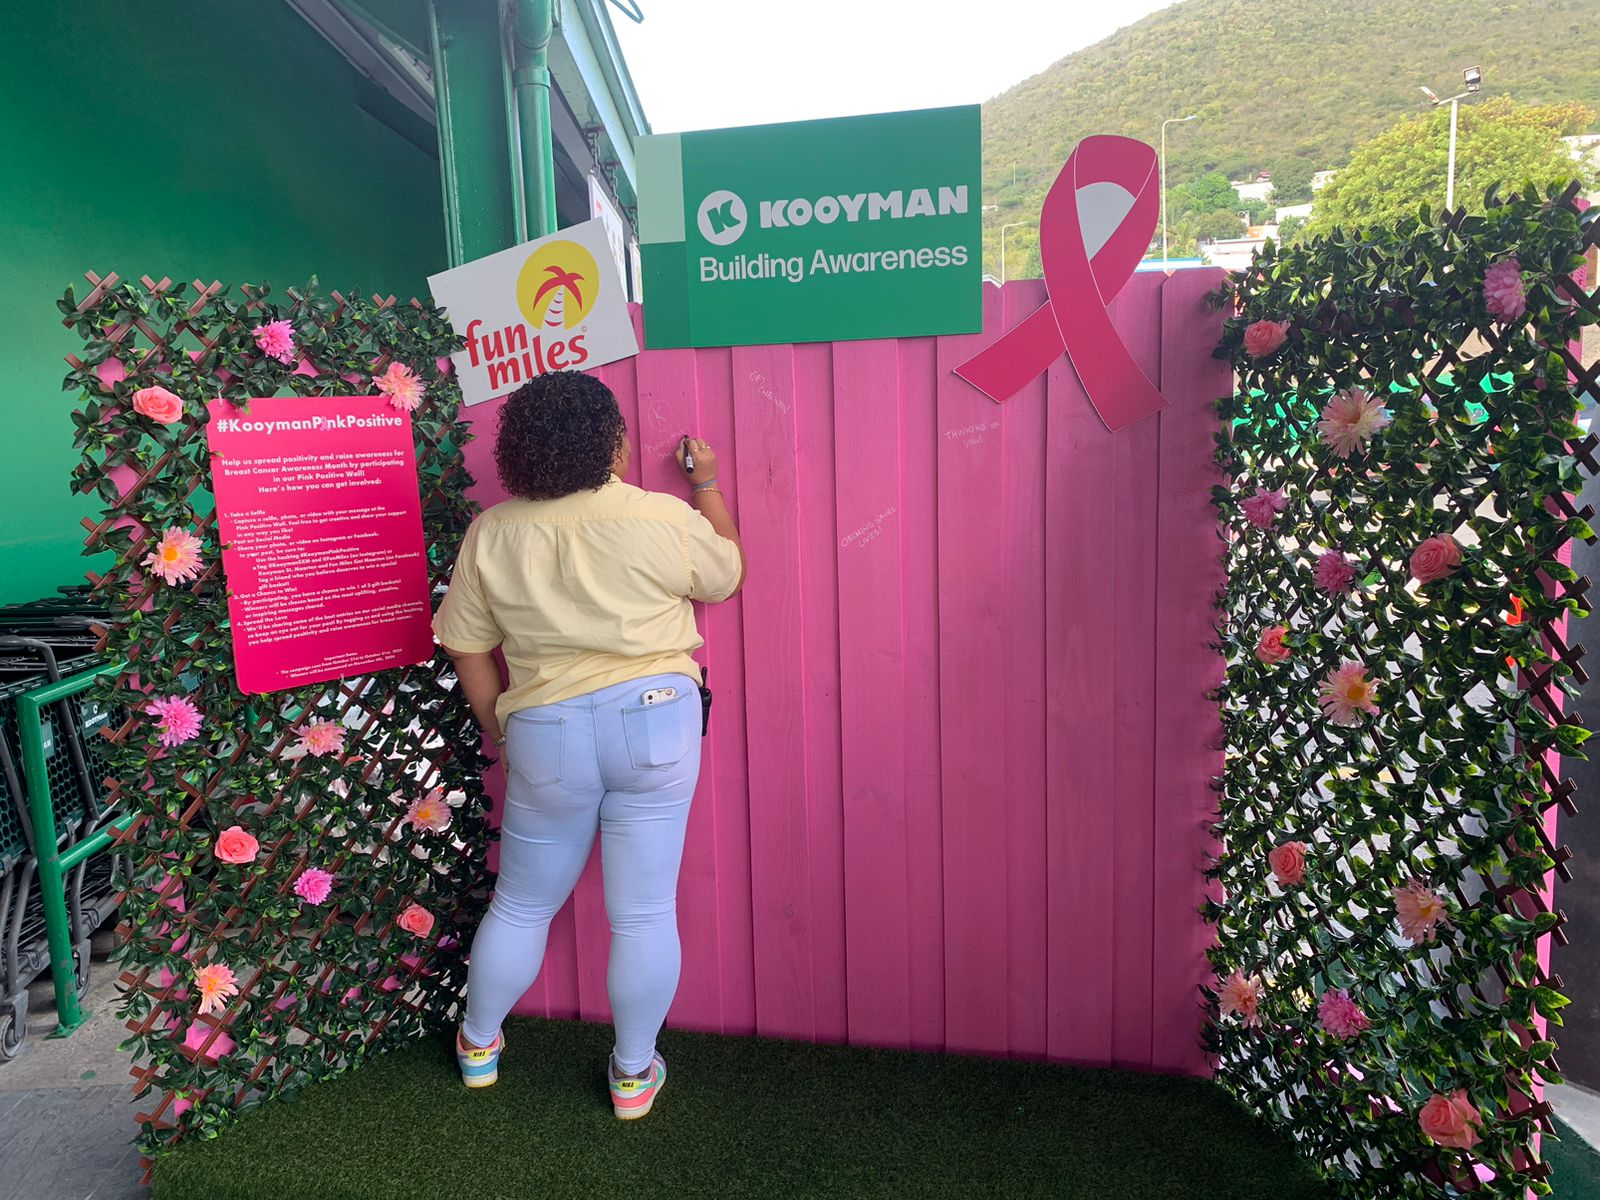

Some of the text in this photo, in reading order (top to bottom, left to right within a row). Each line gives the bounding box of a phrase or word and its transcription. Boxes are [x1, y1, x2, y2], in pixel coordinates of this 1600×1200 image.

[759, 185, 968, 228] KOOYMAN
[699, 245, 968, 283] Building Awareness
[464, 319, 528, 368] fun
[487, 334, 588, 391] miles
[254, 456, 280, 465] spread
[283, 454, 317, 464] positivity
[360, 459, 404, 468] participating
[335, 480, 347, 489] get
